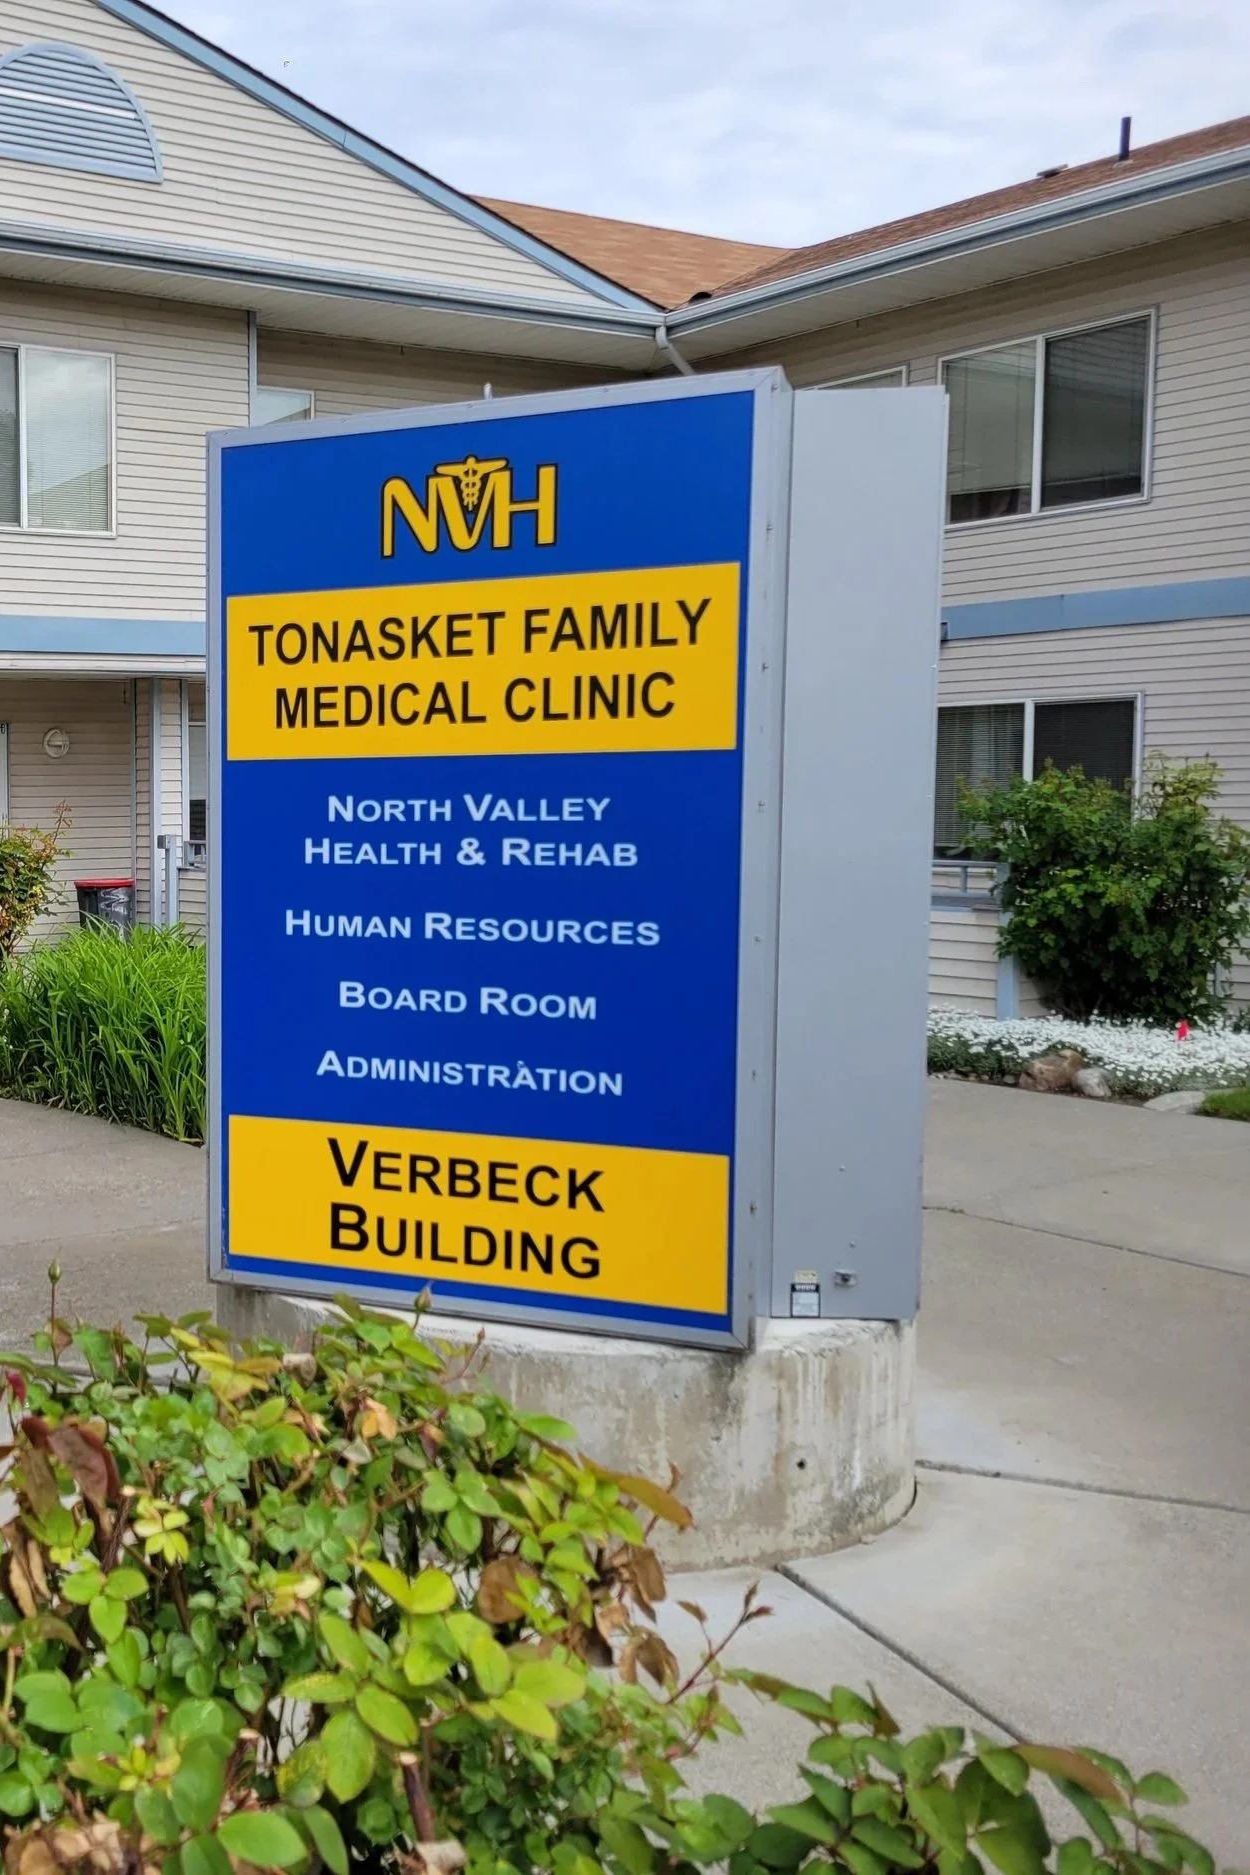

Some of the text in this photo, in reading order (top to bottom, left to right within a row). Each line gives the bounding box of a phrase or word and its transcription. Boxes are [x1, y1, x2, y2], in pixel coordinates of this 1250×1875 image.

[382, 456, 557, 558] NVH
[248, 598, 711, 666] TONASKET FAMILY
[275, 671, 675, 729] MEDICAL CLINIC
[327, 794, 610, 822] NORTH VALLEY
[305, 838, 637, 866] HEALTH & REHAB
[285, 909, 660, 946] HUMAN RESOURCES
[339, 981, 597, 1019] BOARD ROOM
[316, 1050, 622, 1095] ADMINISTRATION
[327, 1137, 604, 1212] VERBECK
[330, 1202, 601, 1280] BUILDING
